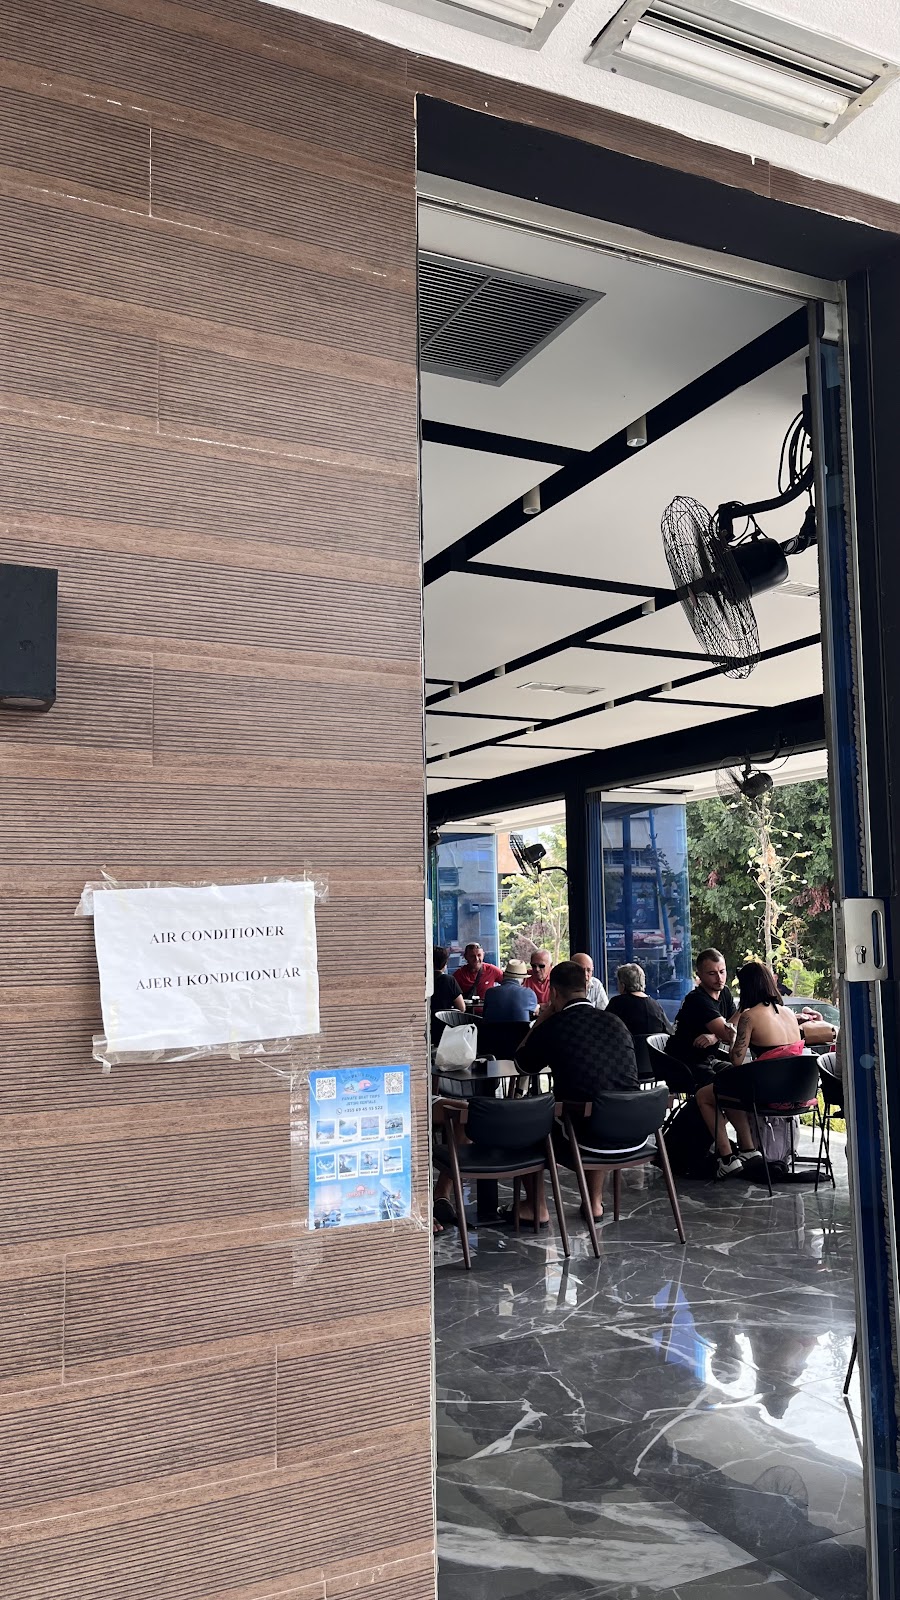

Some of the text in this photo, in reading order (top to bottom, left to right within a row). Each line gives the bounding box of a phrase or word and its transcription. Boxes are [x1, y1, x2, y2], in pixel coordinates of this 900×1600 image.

[149, 925, 285, 944] AIR CONDITIONER
[135, 966, 301, 991] AJER I KONDICIONUAR
